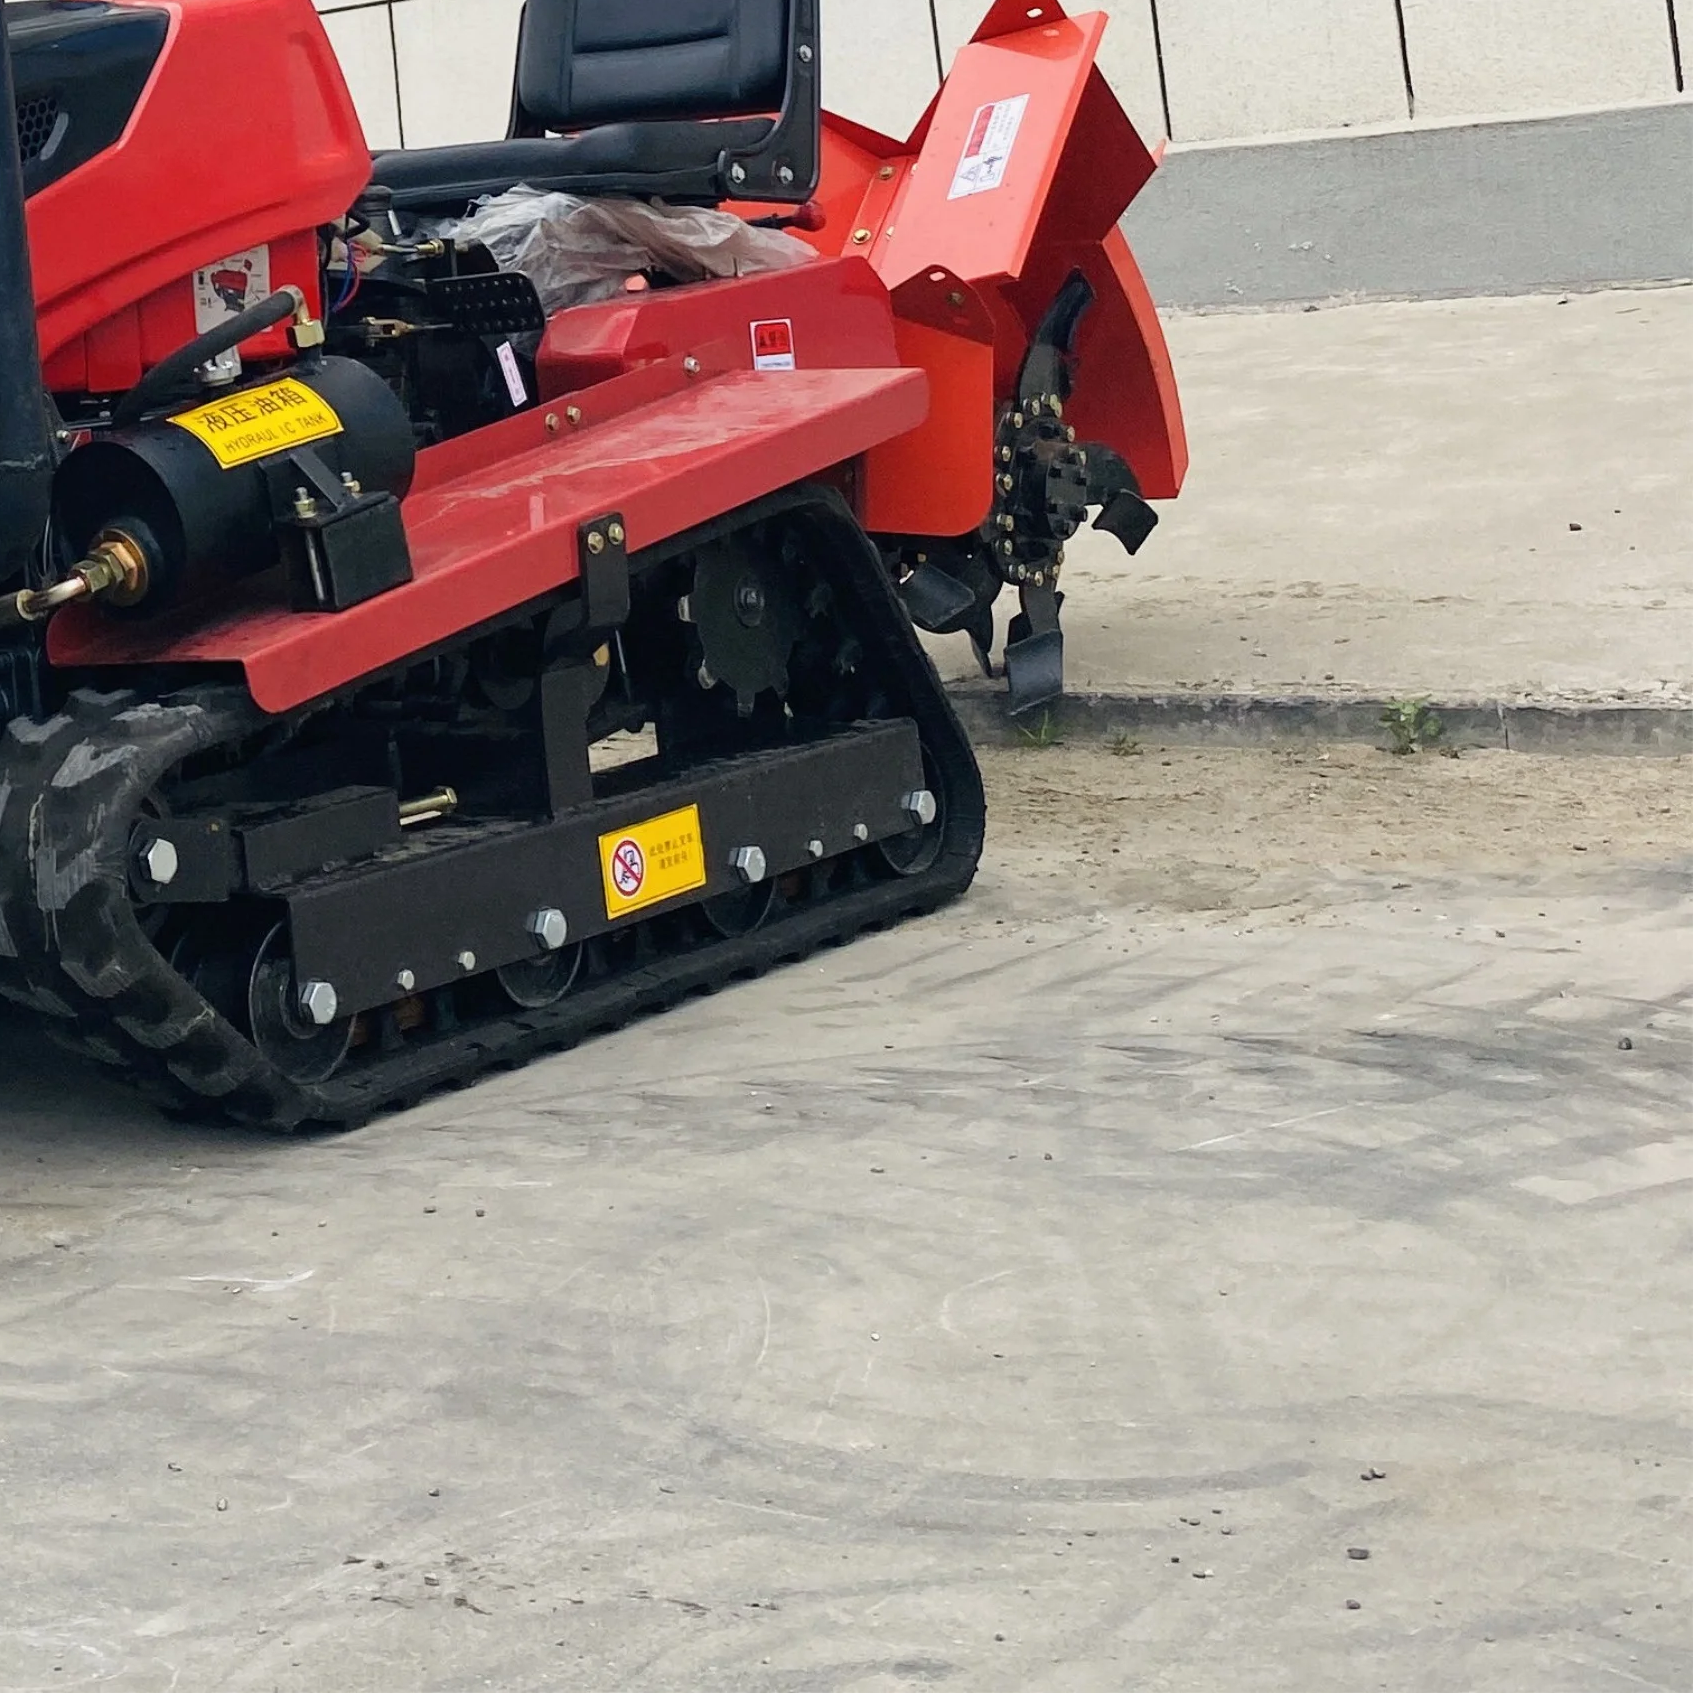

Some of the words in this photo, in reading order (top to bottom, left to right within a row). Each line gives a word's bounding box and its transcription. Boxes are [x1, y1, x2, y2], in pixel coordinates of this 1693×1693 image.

[193, 386, 308, 434] 液压油箱
[296, 412, 327, 429] TANK
